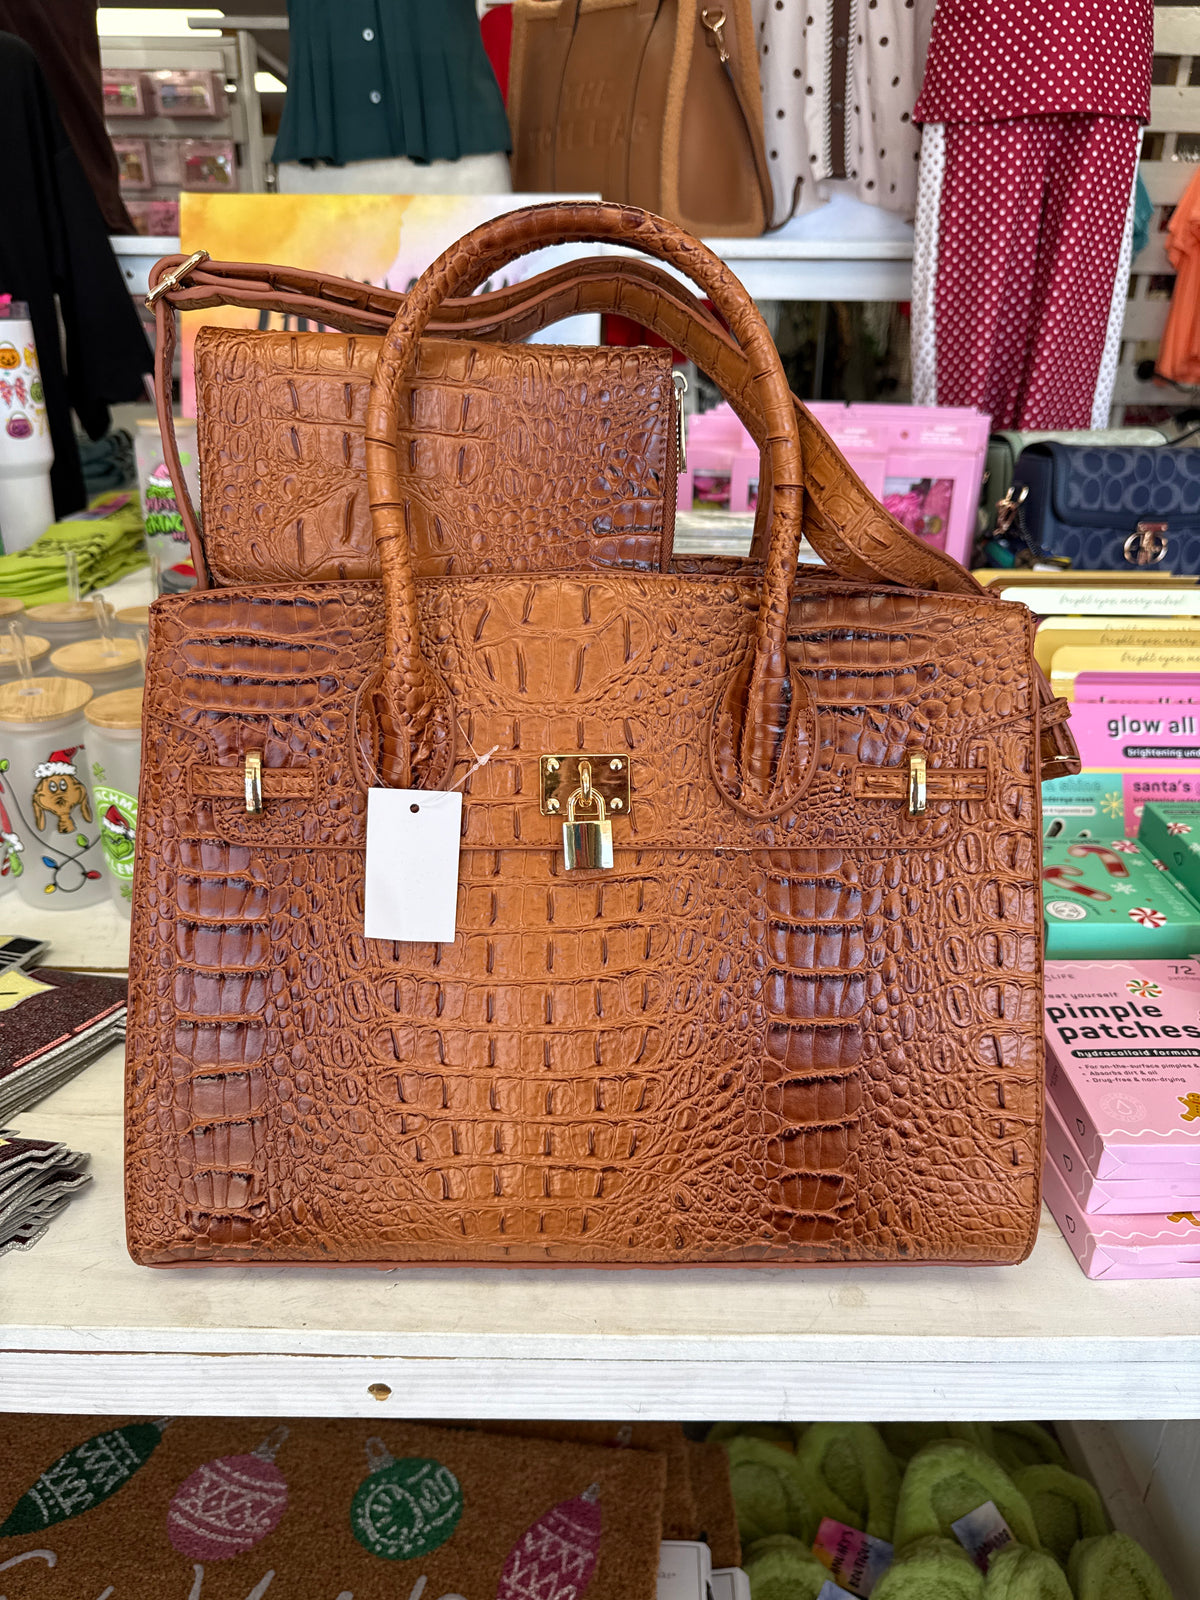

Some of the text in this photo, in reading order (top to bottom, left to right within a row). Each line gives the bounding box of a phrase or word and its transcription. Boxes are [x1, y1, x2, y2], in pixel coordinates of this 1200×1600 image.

[1108, 715, 1194, 738] glow all
[1127, 748, 1182, 758] brightening
[1133, 780, 1191, 793] santa's
[1167, 965, 1196, 976] 72
[1046, 1002, 1163, 1024] pimple
[1057, 1021, 1200, 1045] patches
[1076, 1050, 1151, 1058] hydrocolloid
